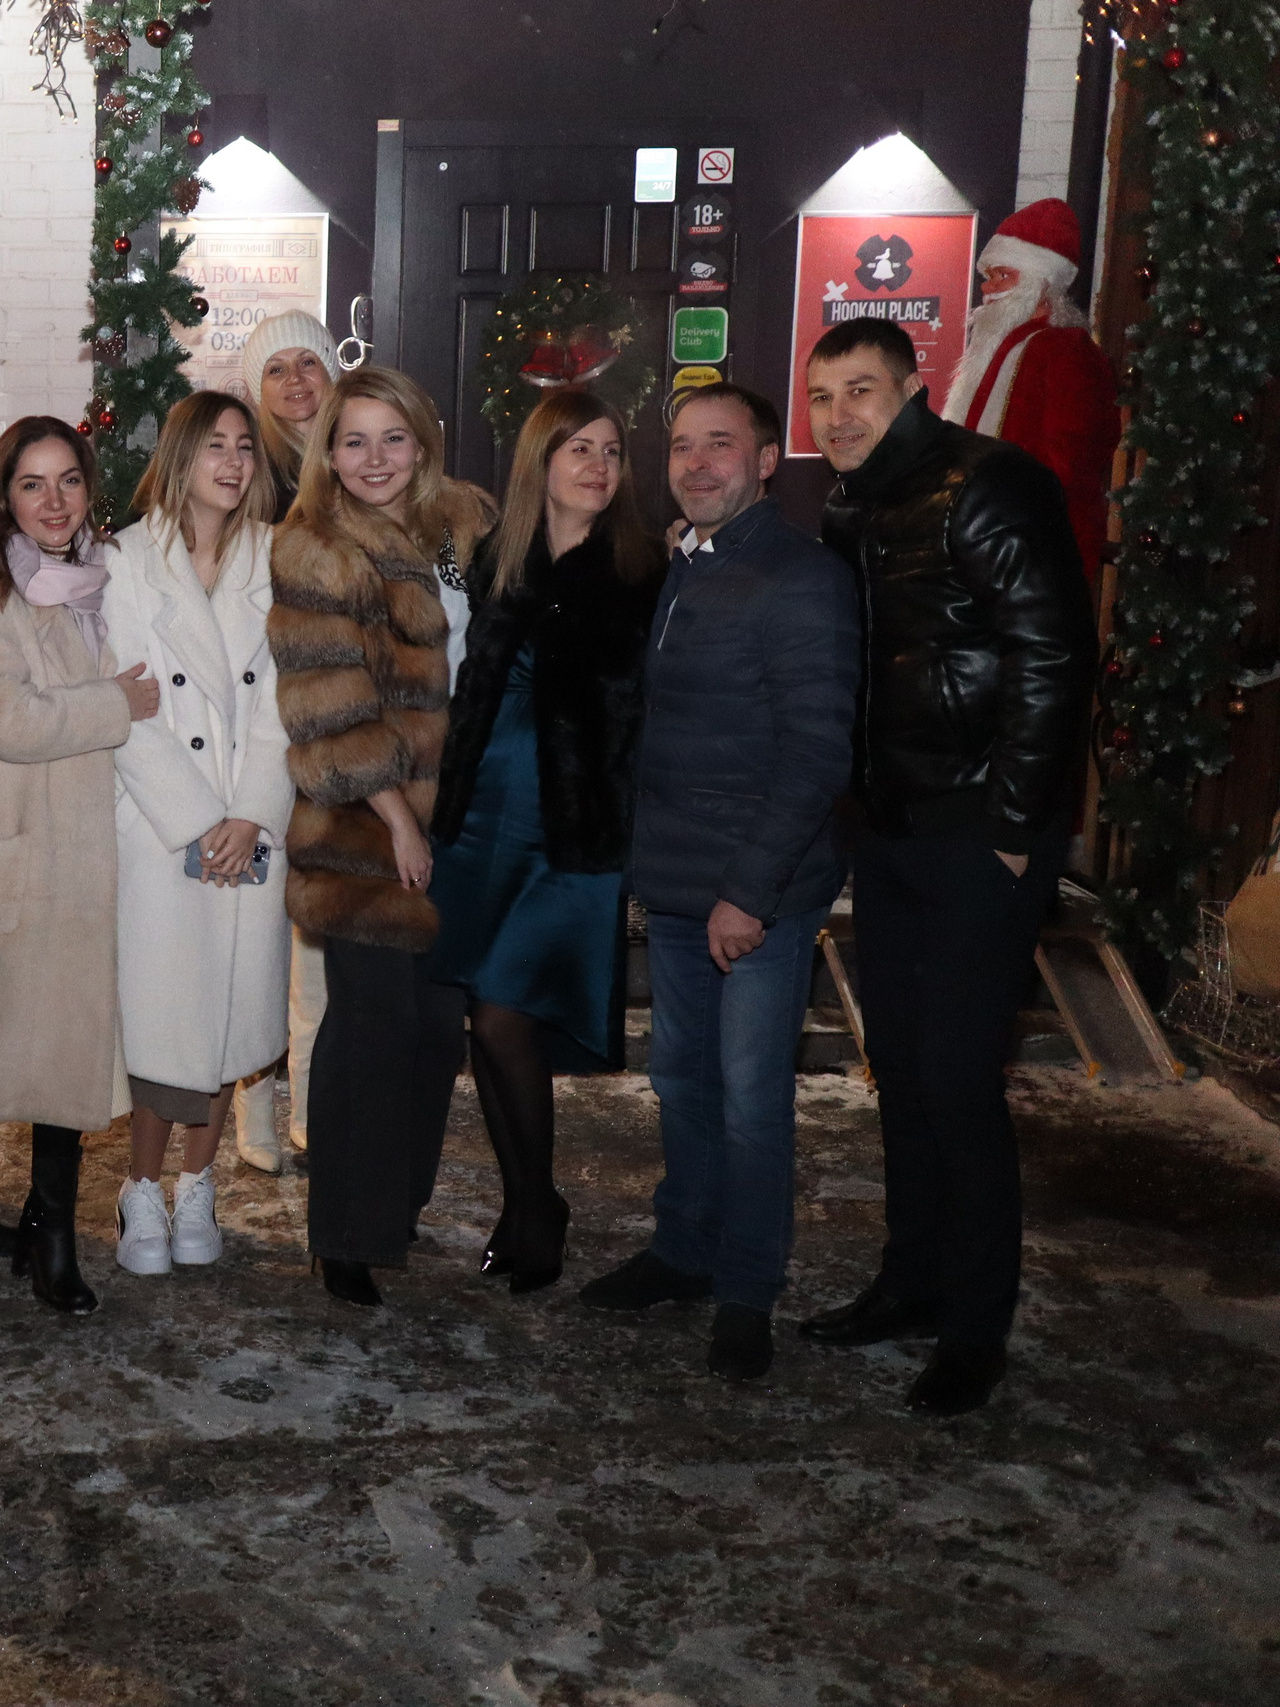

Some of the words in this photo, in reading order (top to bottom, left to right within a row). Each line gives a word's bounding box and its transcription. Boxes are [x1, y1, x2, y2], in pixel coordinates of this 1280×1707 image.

[694, 204, 723, 225] 18+
[182, 266, 300, 284] РАБОТАЕМ
[211, 307, 267, 326] 12:00
[831, 301, 886, 321] HOOKAH
[888, 301, 930, 321] PLACE
[680, 327, 720, 337] Delivery
